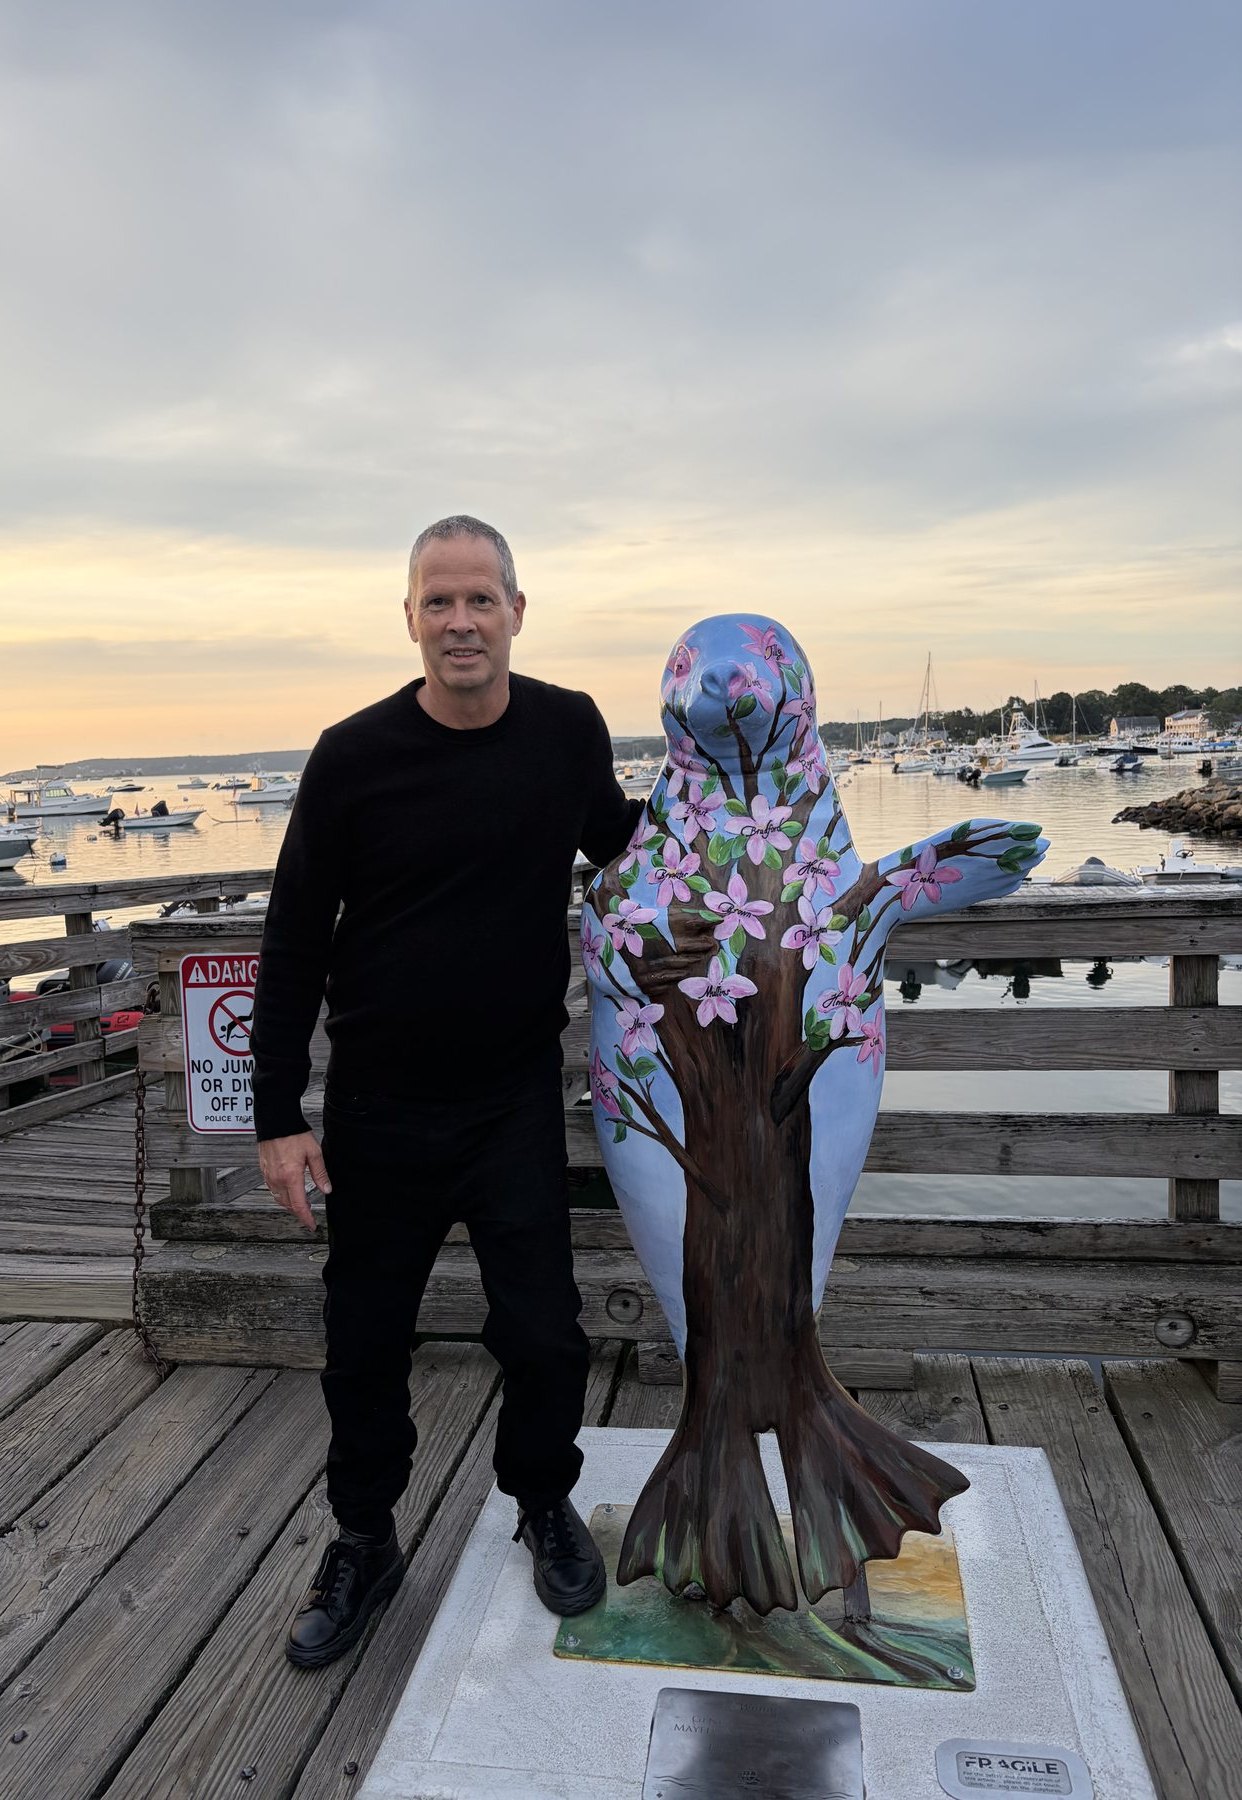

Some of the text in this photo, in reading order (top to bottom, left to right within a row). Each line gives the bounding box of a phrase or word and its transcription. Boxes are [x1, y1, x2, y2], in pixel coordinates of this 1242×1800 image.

[740, 817, 785, 839] Bradford
[910, 871, 936, 884] Cooke
[718, 901, 753, 918] Brown
[207, 960, 259, 984] DANG
[191, 1059, 213, 1074] NO
[201, 1078, 223, 1093] OR
[211, 1096, 239, 1112] OFF
